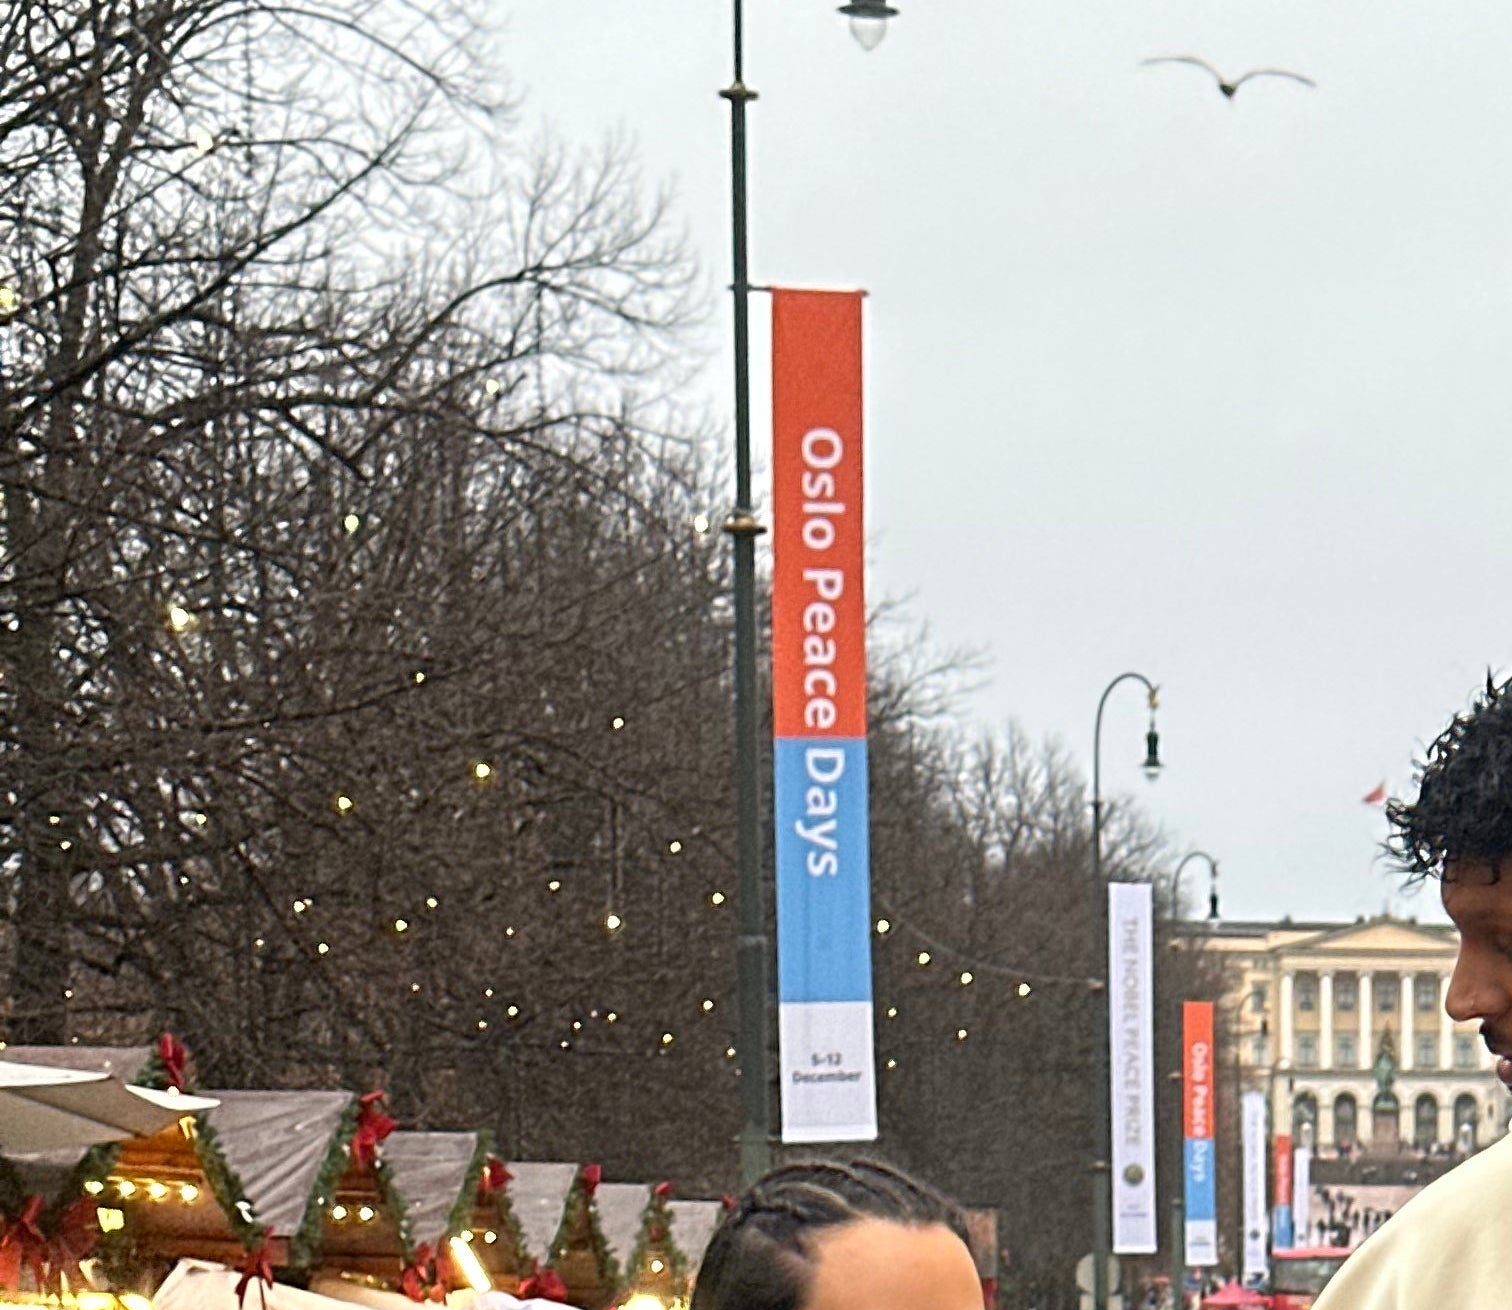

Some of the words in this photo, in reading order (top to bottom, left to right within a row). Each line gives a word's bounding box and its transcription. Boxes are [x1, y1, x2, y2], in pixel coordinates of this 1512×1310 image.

[801, 427, 846, 551] Oslo
[803, 568, 845, 729] Peace
[795, 746, 846, 878] Days
[1121, 917, 1139, 954] THE
[792, 1070, 863, 1086] December
